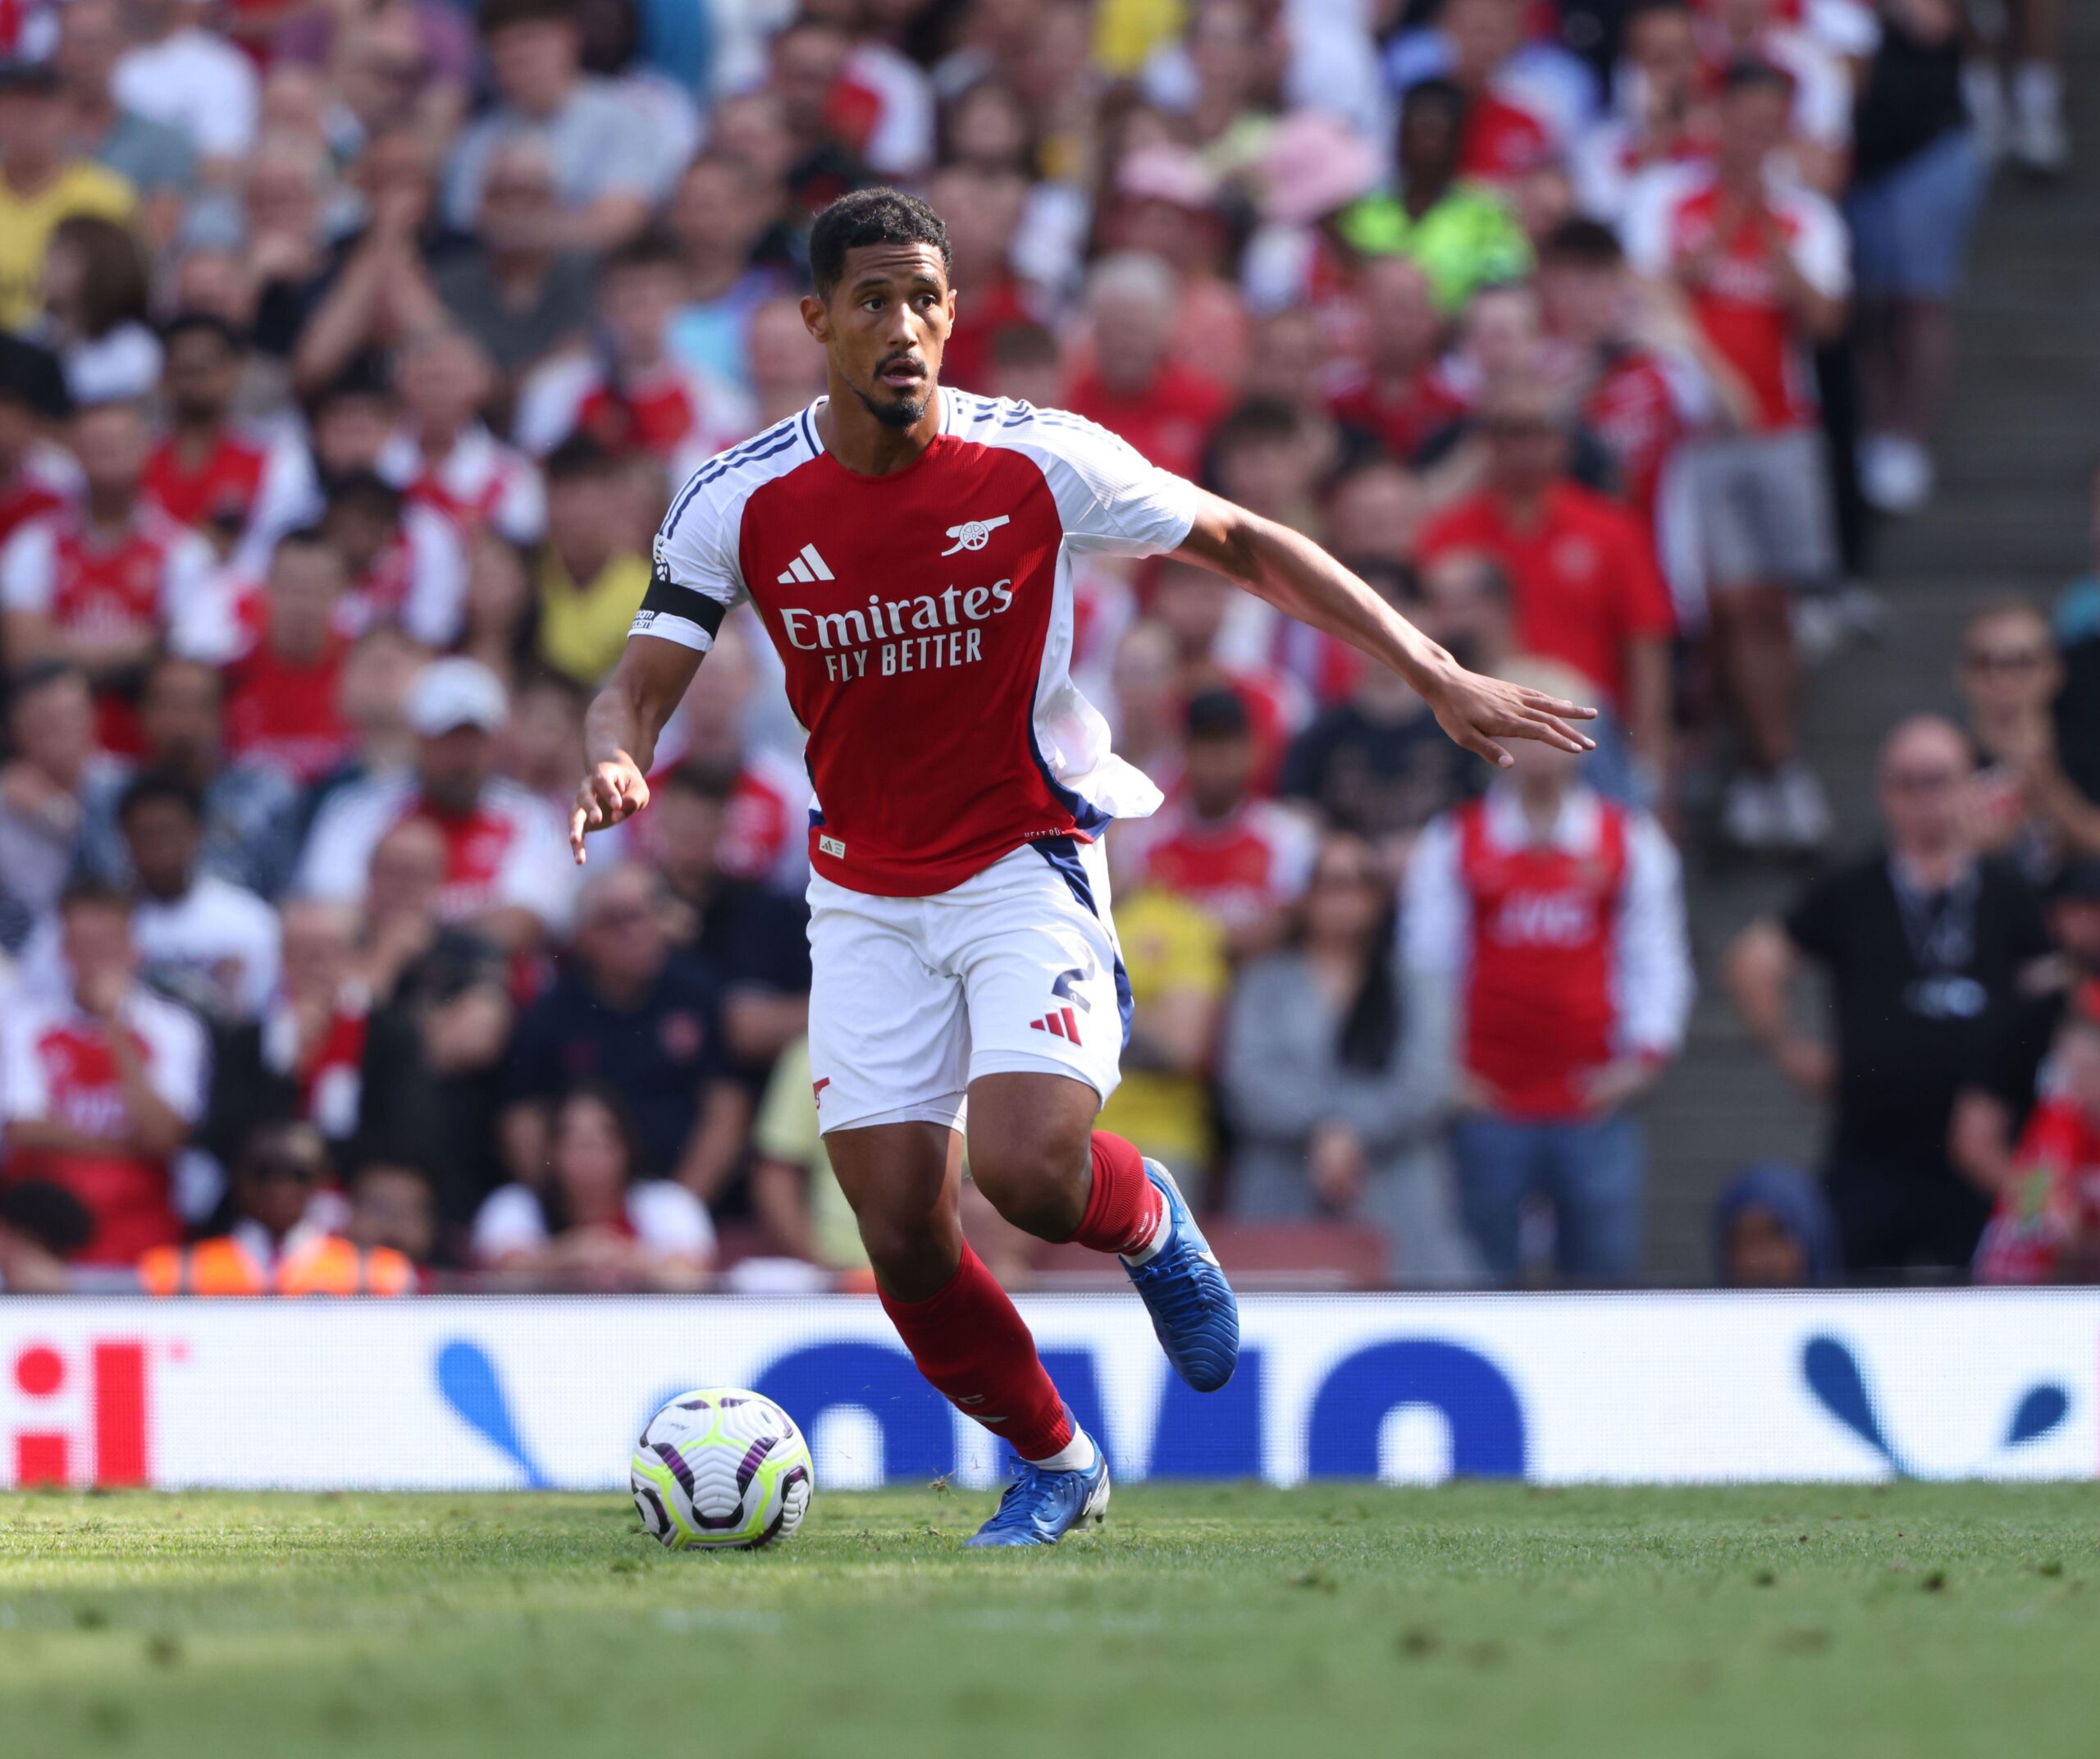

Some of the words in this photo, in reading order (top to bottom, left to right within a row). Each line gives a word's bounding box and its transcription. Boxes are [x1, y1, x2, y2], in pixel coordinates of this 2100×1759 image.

[779, 578, 1013, 651] Emirates
[825, 649, 867, 683] FLY
[882, 628, 982, 676] BETTER
[1051, 940, 1095, 1013] 2
